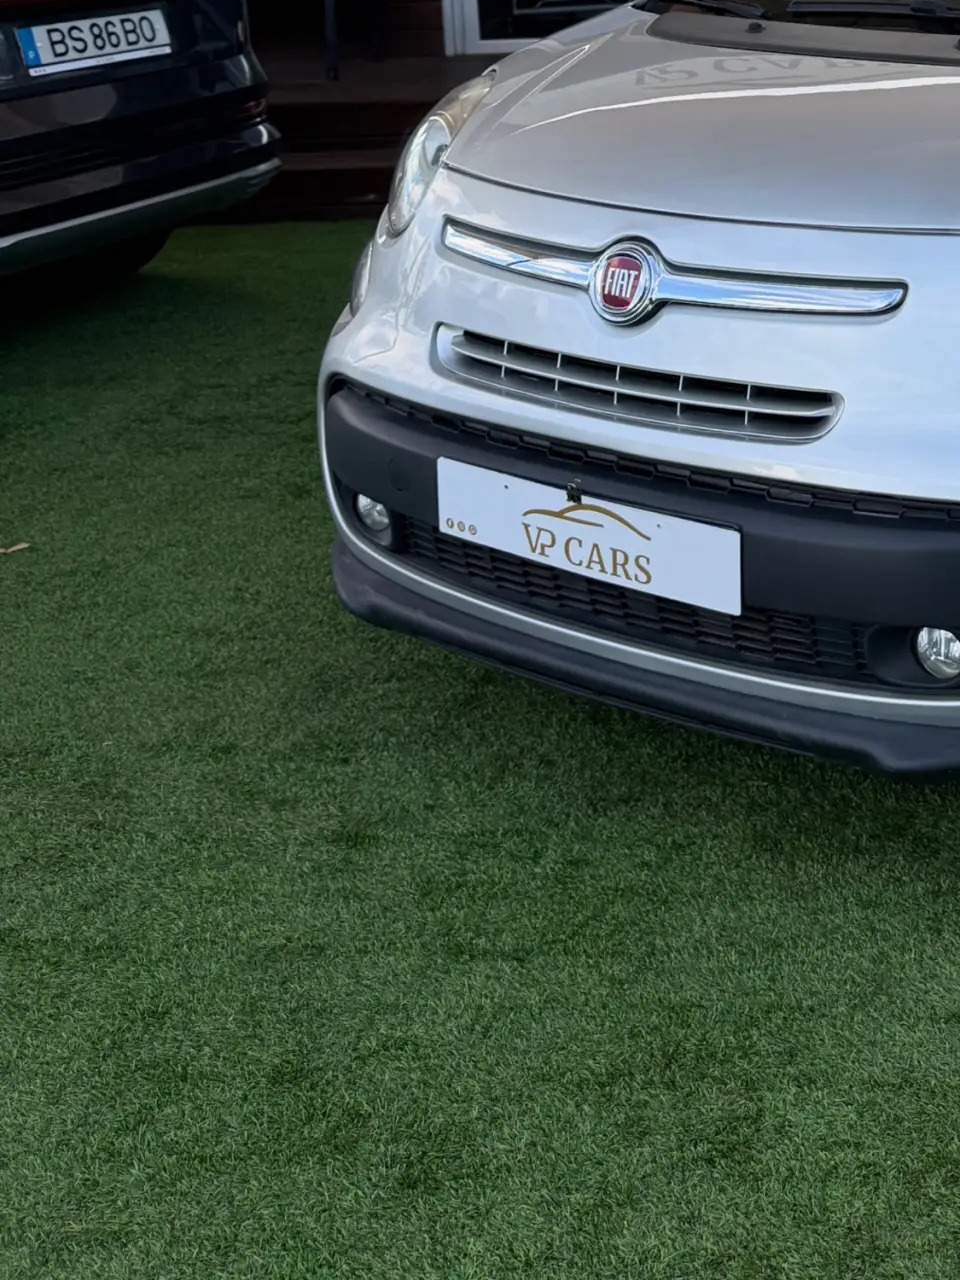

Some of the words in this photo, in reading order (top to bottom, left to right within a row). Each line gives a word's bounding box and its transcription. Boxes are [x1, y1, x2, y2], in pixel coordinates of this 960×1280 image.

[604, 267, 639, 298] FIAT
[521, 522, 556, 558] VP
[564, 536, 652, 585] CARS
